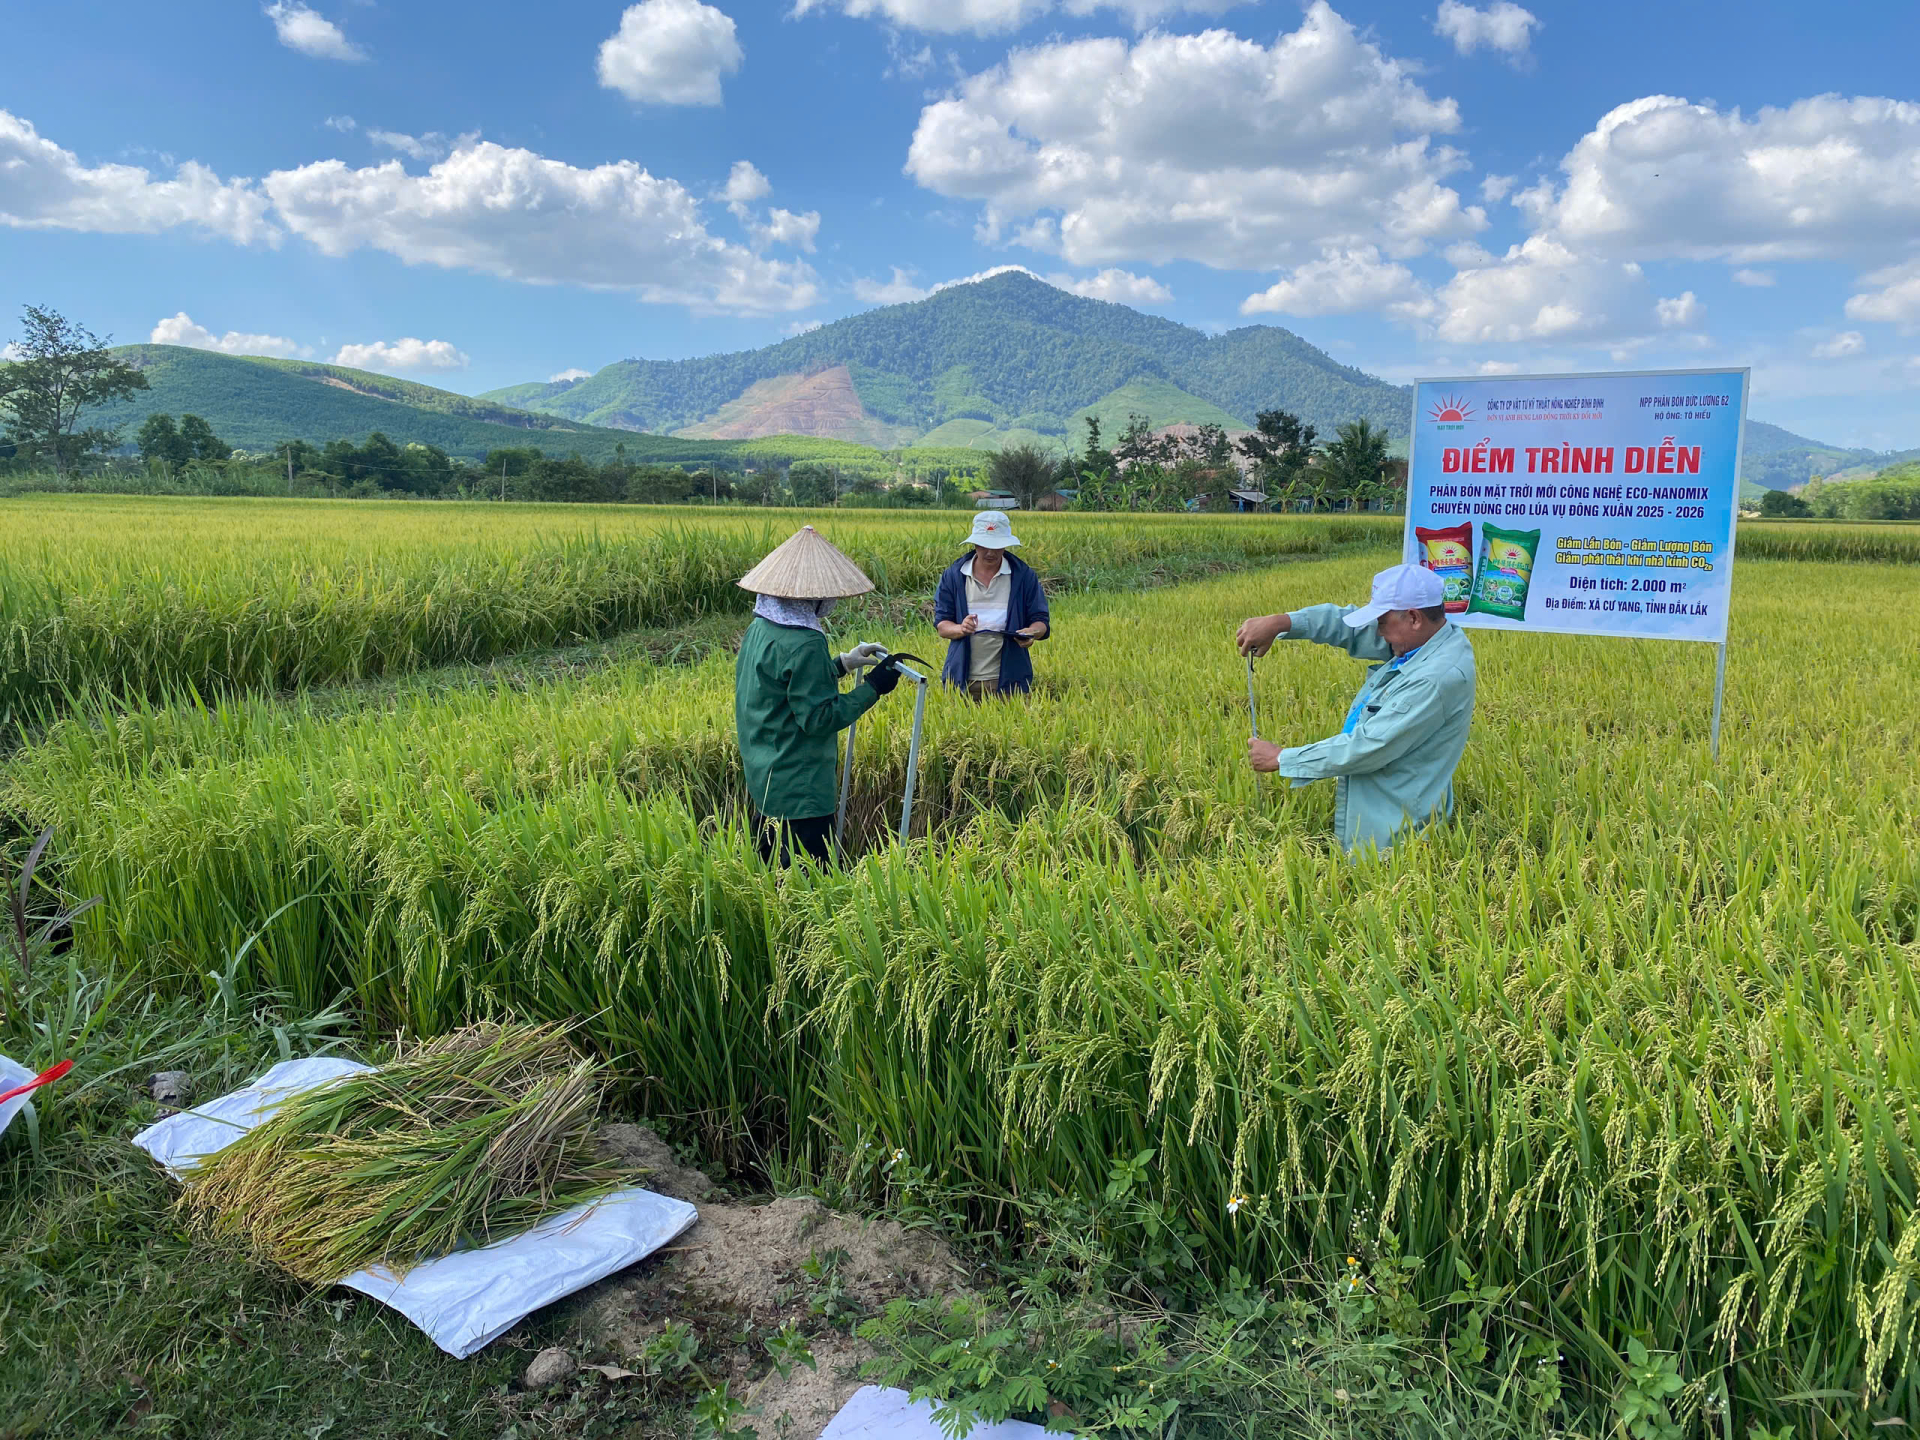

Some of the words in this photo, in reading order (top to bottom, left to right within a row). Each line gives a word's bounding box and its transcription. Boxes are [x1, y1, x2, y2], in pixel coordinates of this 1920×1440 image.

[1639, 397, 1653, 408] NPP
[1653, 394, 1671, 408] PHÂN
[1442, 437, 1515, 473] ĐIỂM
[1525, 441, 1614, 473] TRÌNH
[1624, 436, 1700, 473] DIỄN
[1430, 483, 1457, 497] PHÂN
[1460, 483, 1481, 498] BÓN
[1484, 483, 1507, 500] MẶT
[1509, 483, 1533, 498] TRỜI
[1536, 484, 1557, 498] MỚI
[1560, 484, 1590, 499] CÔNG
[1592, 485, 1622, 502] NGHỆ
[1626, 487, 1709, 500] ECO-NANOMIX
[1431, 501, 1470, 515] CHUYÊN
[1473, 501, 1502, 515] DÙNG
[1505, 503, 1526, 516] CHO
[1529, 502, 1549, 516] LÚA
[1552, 504, 1566, 519] VỤ
[1569, 502, 1599, 517] ĐÔNG
[1602, 503, 1633, 517] XUÂN
[1636, 505, 1664, 518] 2025
[1675, 506, 1705, 518] 2026
[1557, 536, 1582, 550] Giảm
[1602, 538, 1622, 551] Bón
[1630, 538, 1657, 552] Giảm
[1659, 540, 1690, 554] Lượng
[1692, 540, 1713, 553] Bón
[1556, 551, 1581, 565] Giảm
[1582, 552, 1604, 566] phát
[1644, 554, 1664, 567] nhà
[1569, 576, 1597, 592] Diện
[1600, 576, 1628, 591] tích:
[1631, 579, 1666, 592] 2.000
[1545, 597, 1560, 611] Địa
[1561, 596, 1586, 610] Điểm:
[1588, 598, 1601, 611] XÃ
[1617, 600, 1643, 614] YANG,
[1645, 598, 1666, 614] TỈNH
